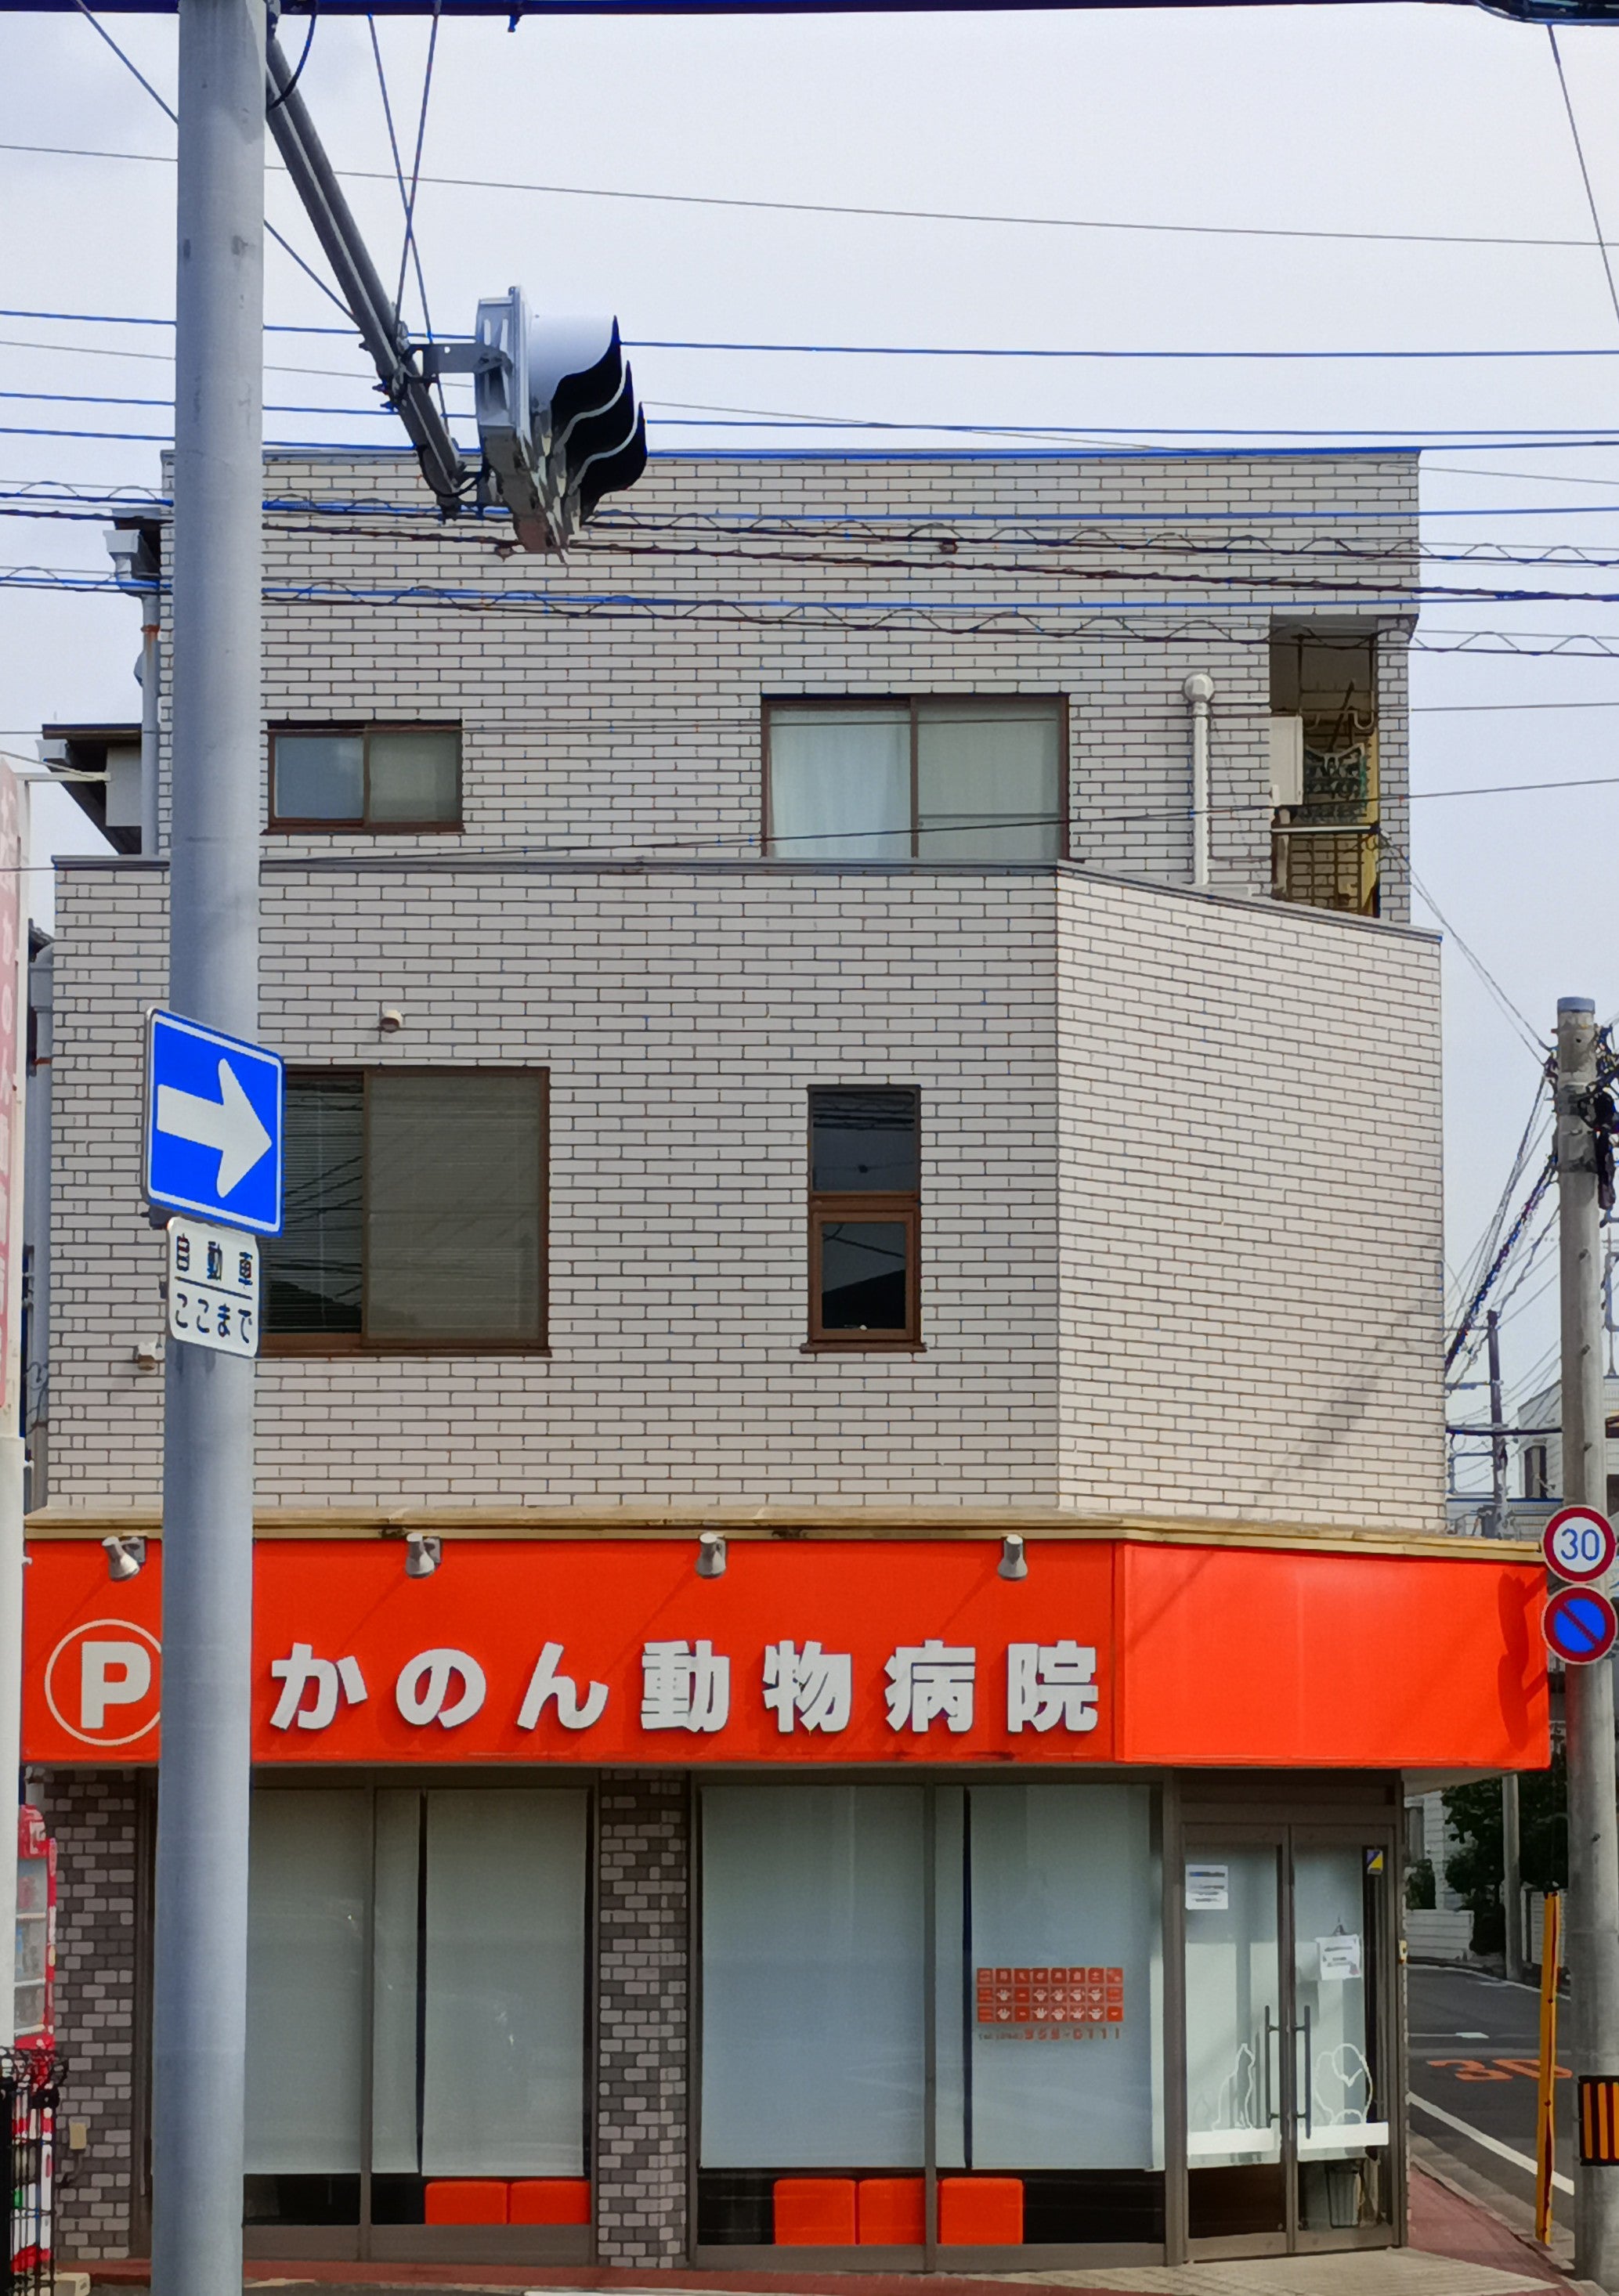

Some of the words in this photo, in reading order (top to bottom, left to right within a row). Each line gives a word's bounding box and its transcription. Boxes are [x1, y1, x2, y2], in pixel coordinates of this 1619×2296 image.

[175, 1293, 252, 1344] ここまで
[1561, 1528, 1599, 1561] 30
[81, 1641, 151, 1728] P
[269, 1641, 1098, 1733] かのん動物病院
[1427, 2059, 1573, 2081] 30
